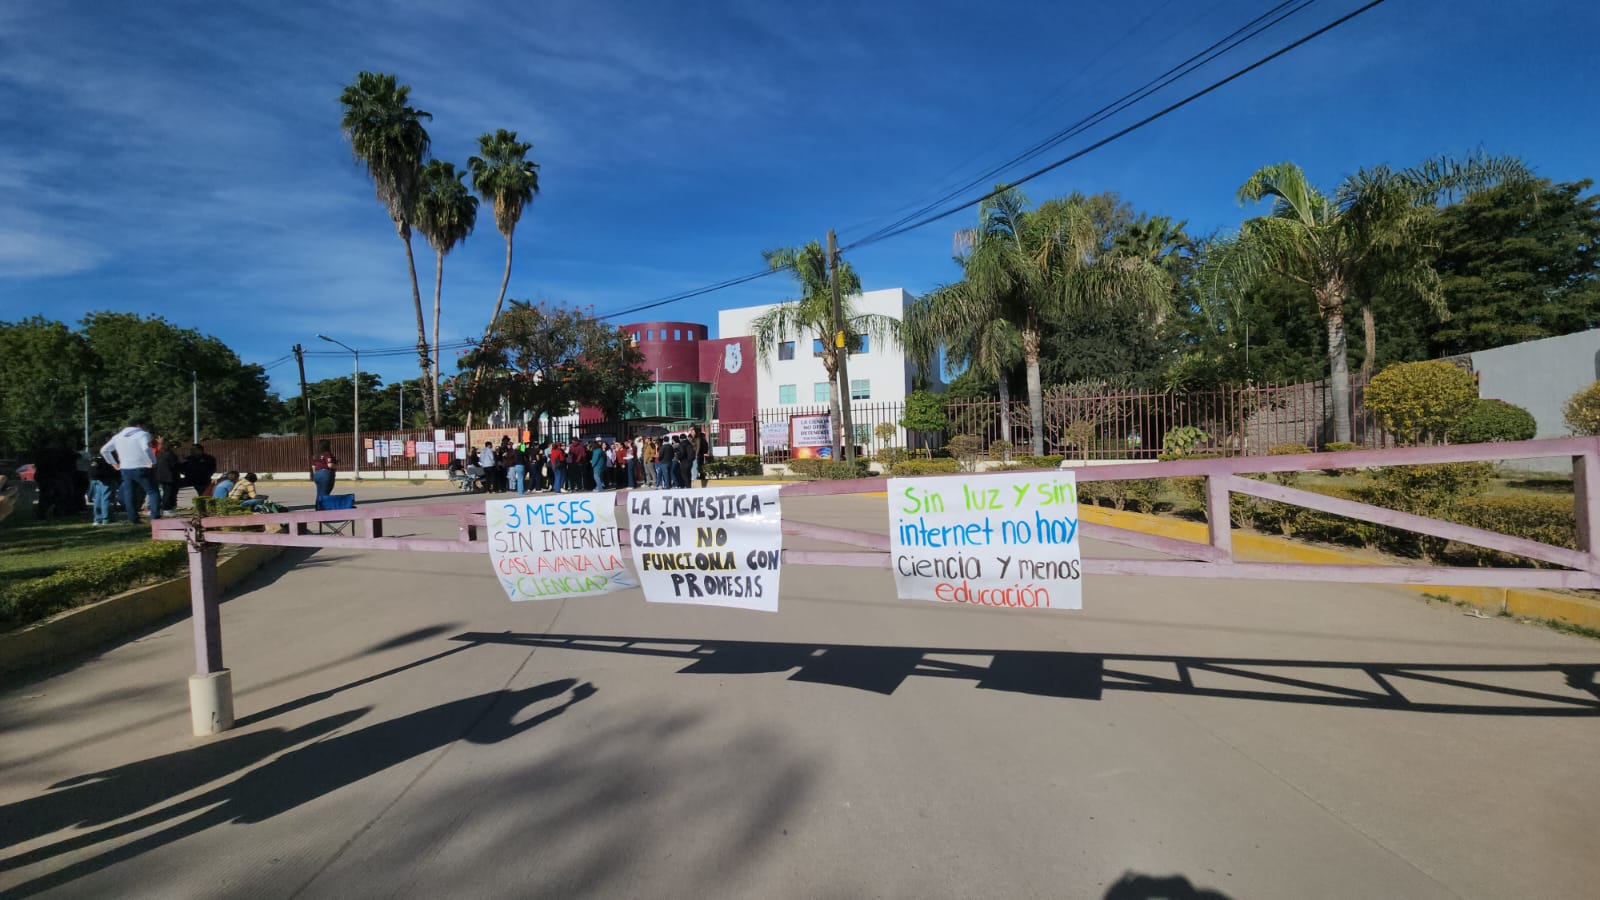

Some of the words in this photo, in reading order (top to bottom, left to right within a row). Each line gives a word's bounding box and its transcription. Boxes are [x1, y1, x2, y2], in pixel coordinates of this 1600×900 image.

[631, 497, 651, 515] LA
[903, 486, 944, 514] Sin
[963, 483, 1003, 510] luz
[1037, 479, 1076, 506] sin
[504, 504, 521, 528] 3
[526, 500, 595, 525] MESES
[494, 530, 534, 554] SIN
[540, 526, 616, 552] INTERNET
[633, 520, 681, 548] CIÓN
[696, 527, 728, 548] NO
[899, 517, 994, 547] internet
[1001, 520, 1031, 545] no
[1035, 510, 1078, 545] hay
[537, 555, 597, 574] AVANZA
[598, 554, 625, 571] LA
[642, 551, 737, 571] FUNCIONA
[746, 549, 779, 570] CON
[1018, 558, 1080, 580] menos
[516, 575, 609, 598] CIENCIA?
[670, 573, 763, 598] PROMESAS
[935, 580, 1050, 608] educación
